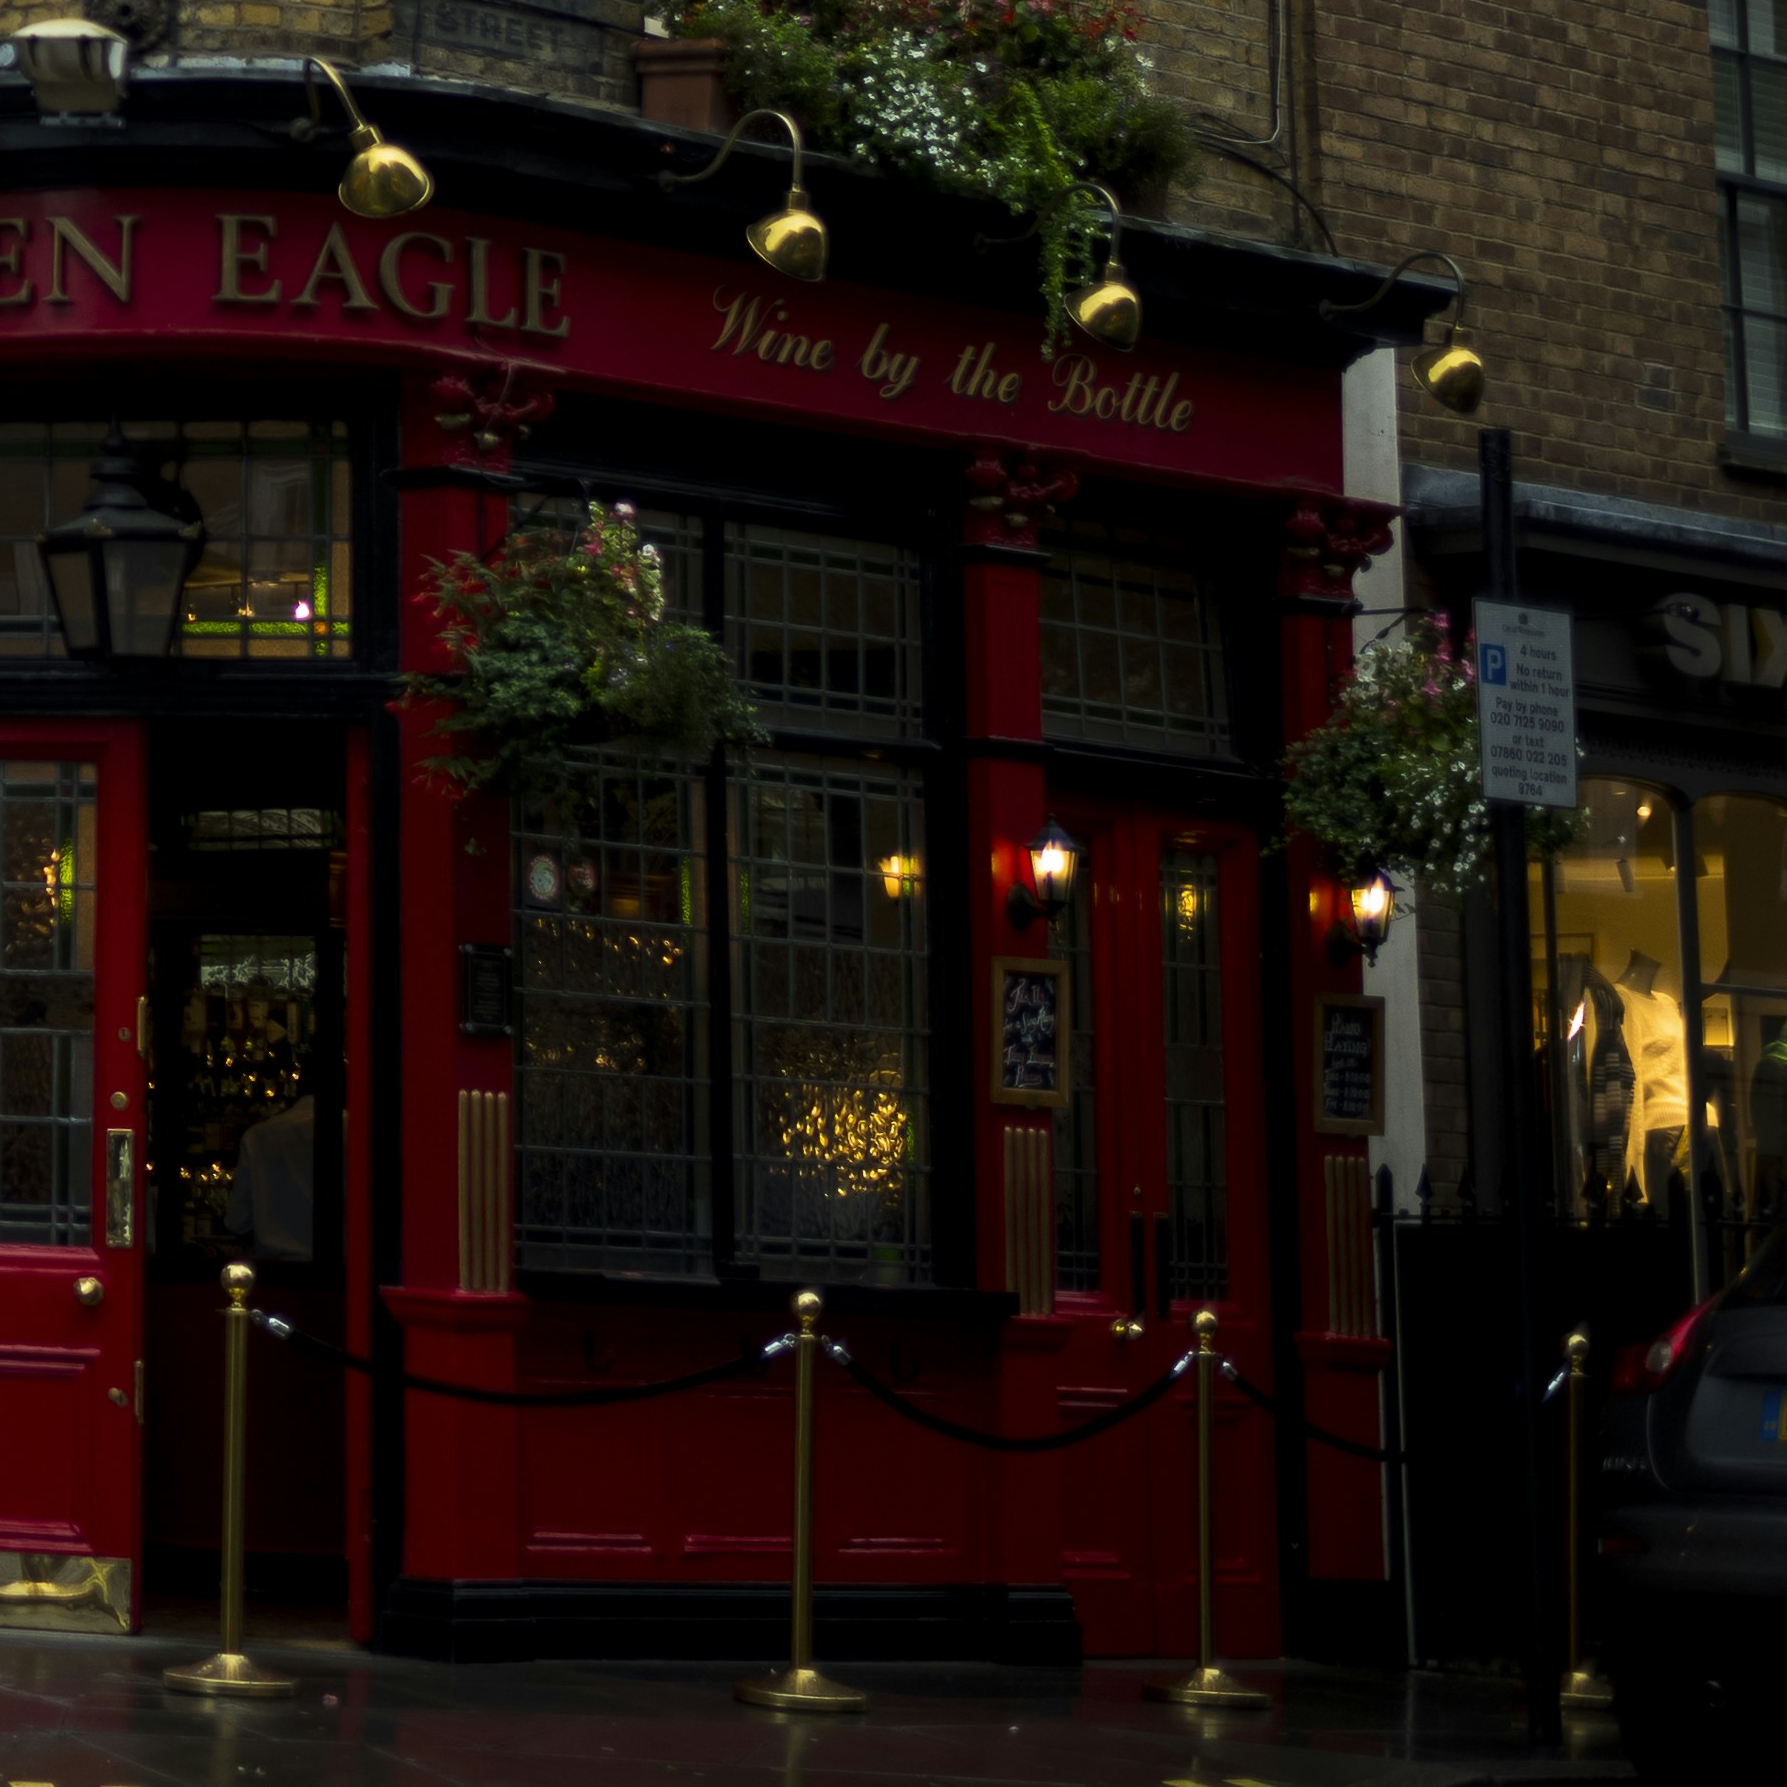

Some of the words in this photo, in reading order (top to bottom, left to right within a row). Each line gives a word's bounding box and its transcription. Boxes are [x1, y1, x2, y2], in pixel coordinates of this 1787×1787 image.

[211, 214, 571, 339] EAGLE
[711, 284, 835, 371] Wine
[861, 321, 921, 400] by
[947, 341, 1023, 403] the
[1047, 352, 1194, 434] Bottle
[1520, 645, 1527, 657] 4
[1530, 646, 1557, 661] hours
[1487, 649, 1503, 680] P
[1516, 663, 1530, 676] No
[1532, 666, 1563, 681] return
[1510, 679, 1538, 694] within
[1547, 684, 1570, 698] hour
[1496, 697, 1512, 711] Pay
[1516, 700, 1527, 714] by
[1530, 702, 1558, 717] phone
[1490, 712, 1510, 726] 020
[1513, 715, 1536, 729] 7125
[1538, 717, 1564, 733] 9090
[1512, 735, 1523, 745] or
[1525, 734, 1545, 747] text
[1548, 752, 1567, 766] 205
[1492, 764, 1527, 782] quoting
[1530, 766, 1568, 784] location
